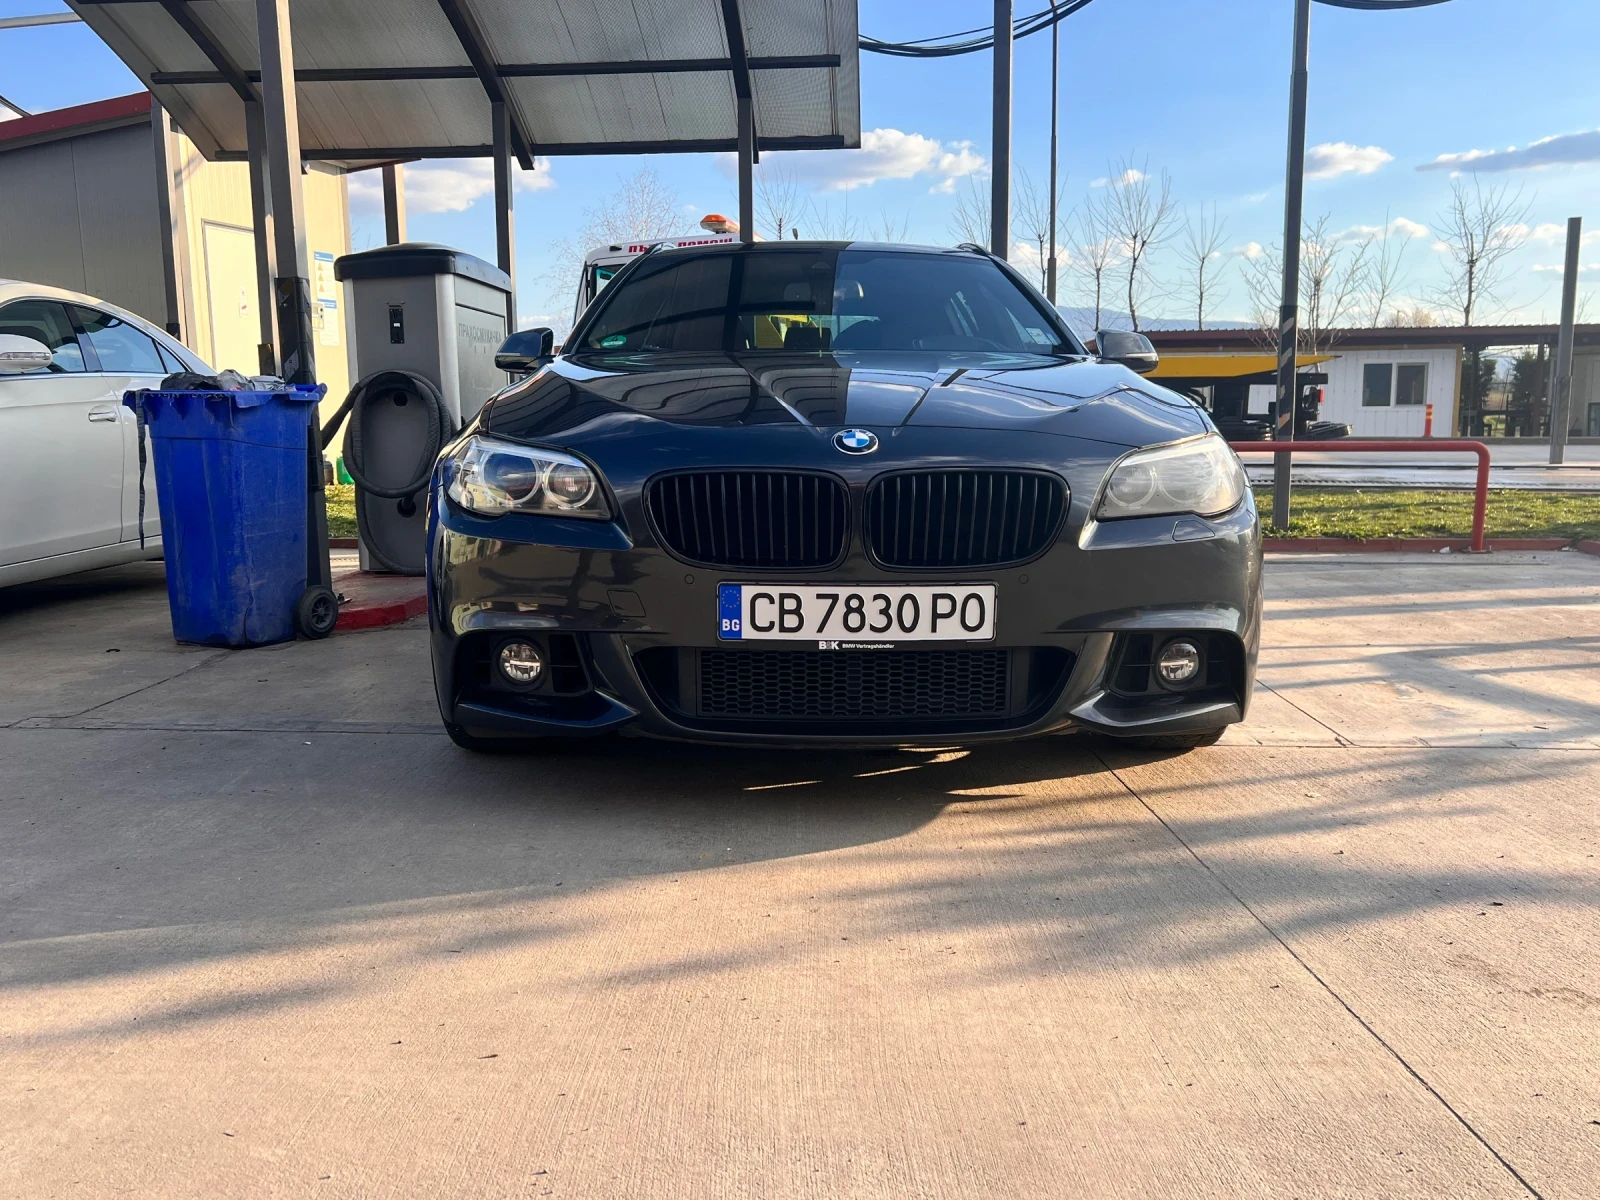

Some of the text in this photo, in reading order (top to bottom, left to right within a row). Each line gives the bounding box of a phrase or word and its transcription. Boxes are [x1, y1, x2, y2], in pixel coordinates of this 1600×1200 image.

[722, 619, 740, 631] BG
[750, 592, 805, 633] CB
[815, 593, 921, 633] 7830
